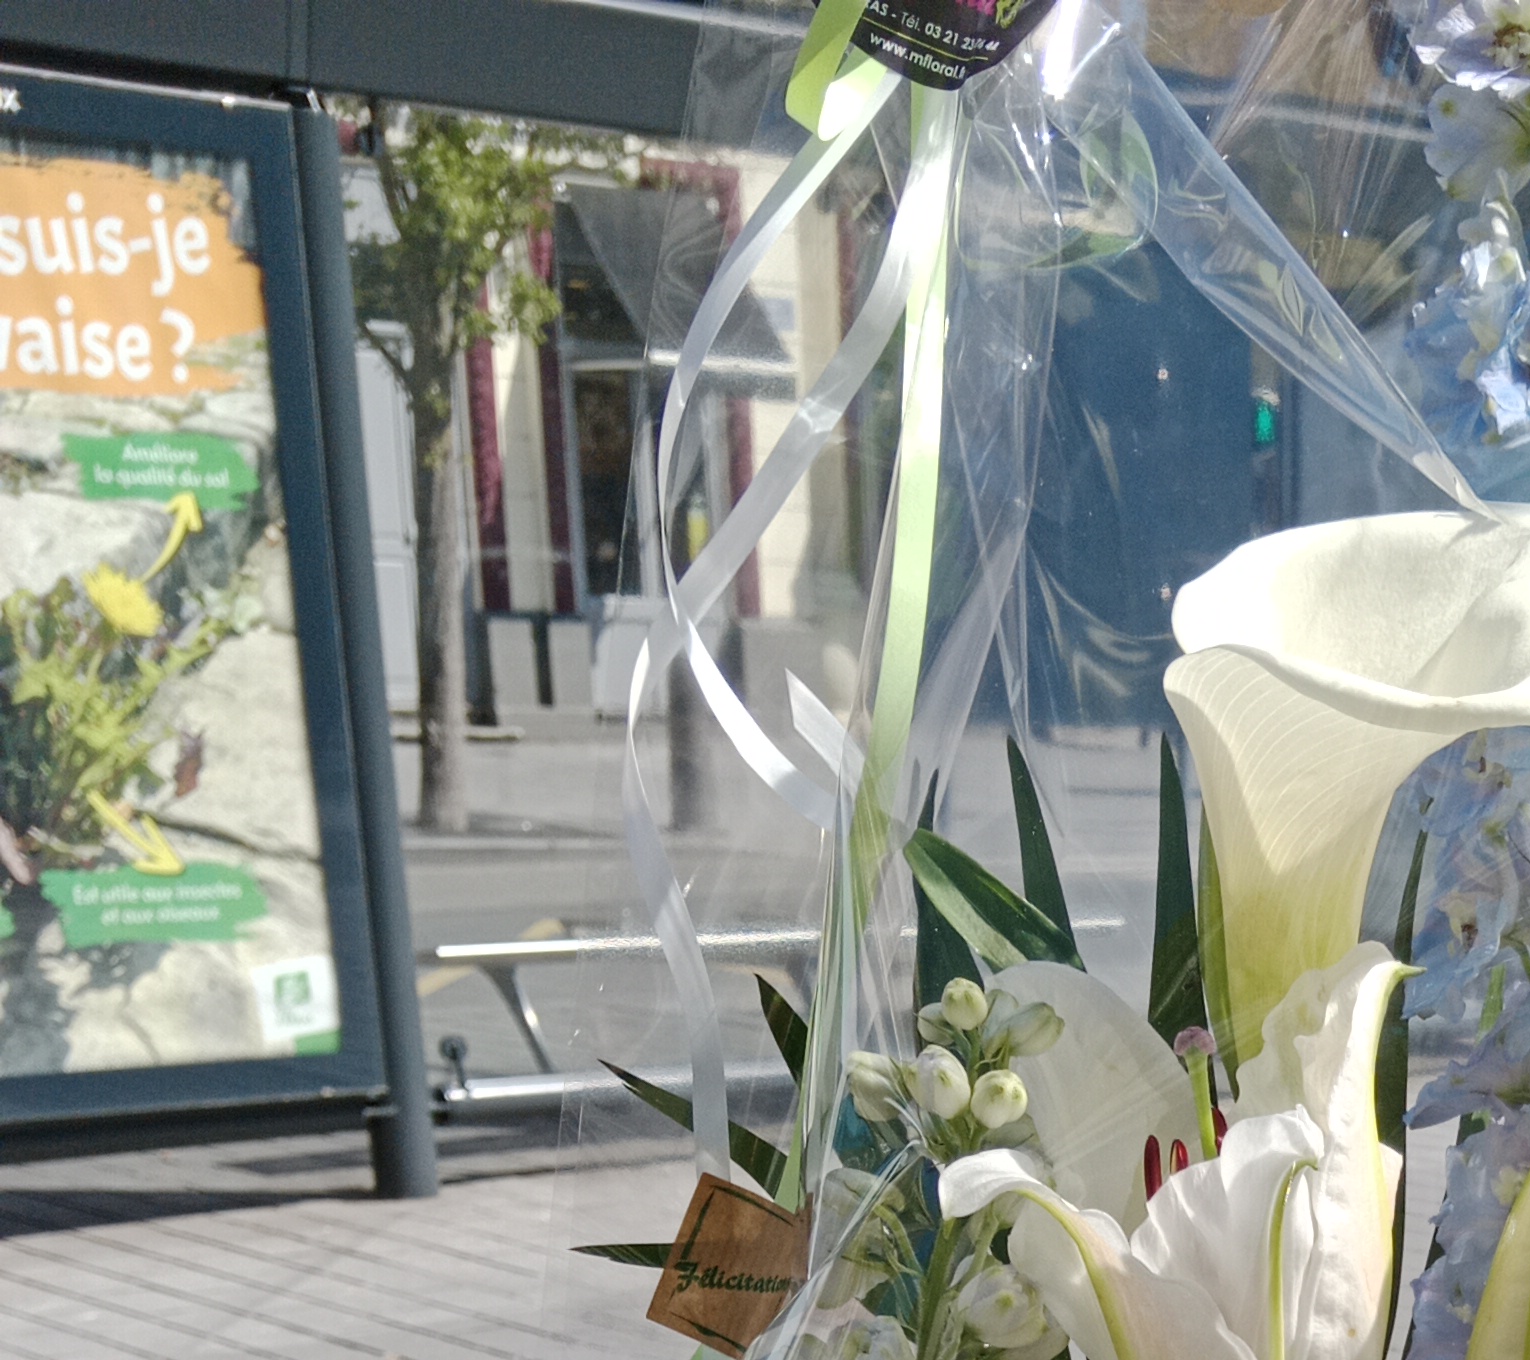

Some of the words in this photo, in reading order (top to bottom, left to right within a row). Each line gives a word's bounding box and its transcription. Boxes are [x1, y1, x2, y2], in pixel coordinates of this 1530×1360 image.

[866, 0, 889, 16] AS
[924, 23, 942, 39] 03
[943, 30, 959, 46] 21
[0, 192, 212, 297] suis-je
[160, 308, 195, 384] ?
[115, 465, 176, 489] qualité
